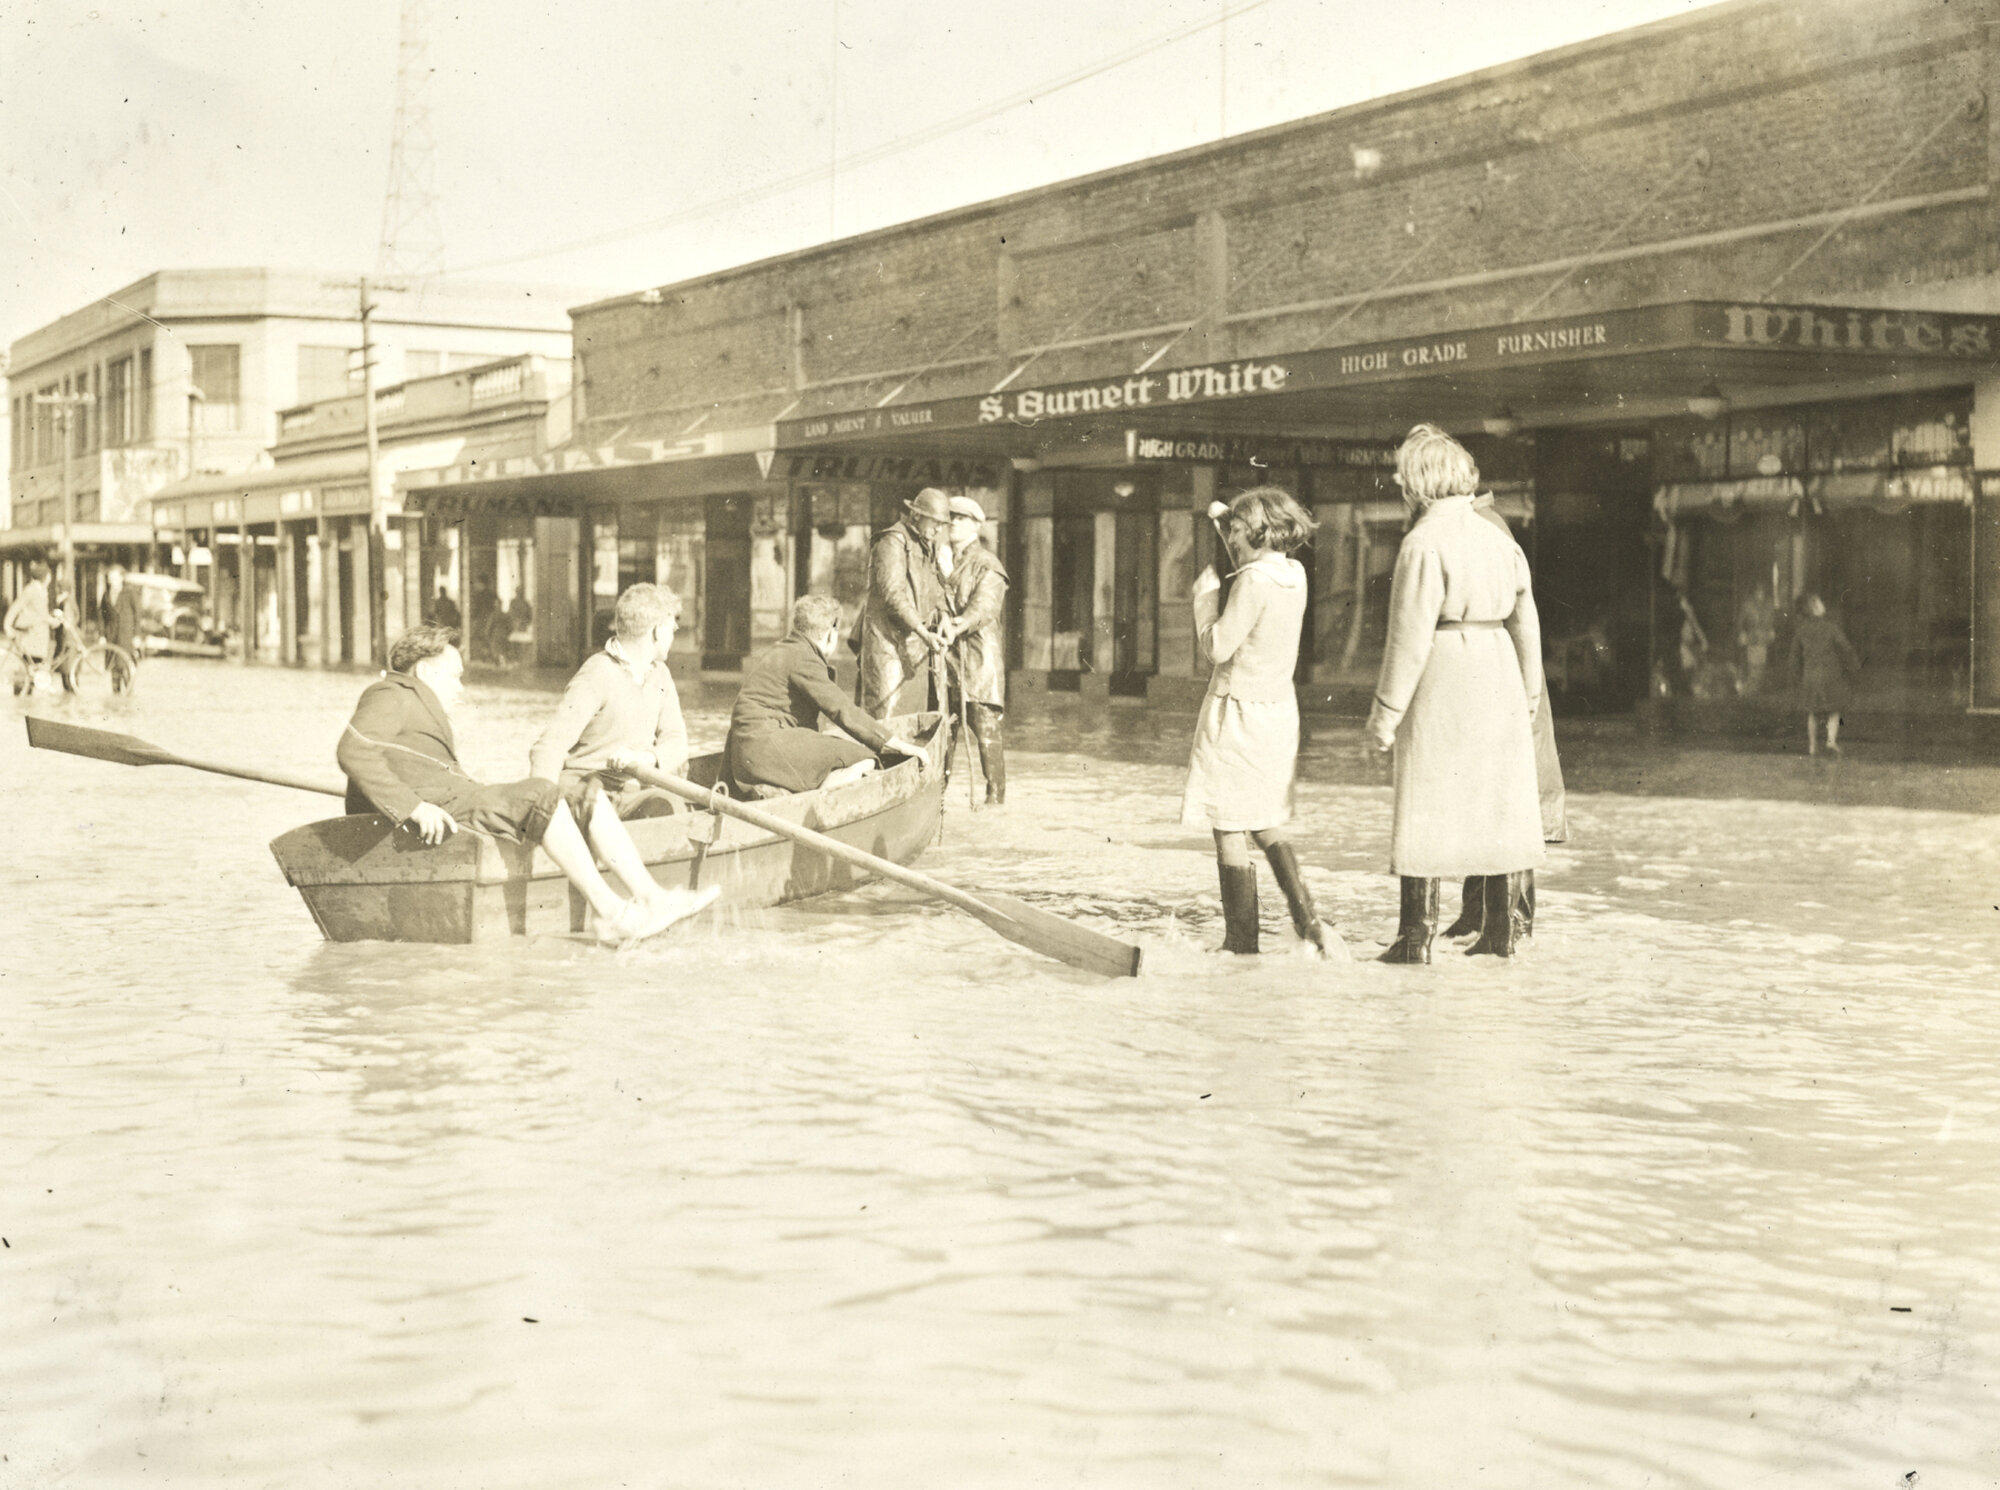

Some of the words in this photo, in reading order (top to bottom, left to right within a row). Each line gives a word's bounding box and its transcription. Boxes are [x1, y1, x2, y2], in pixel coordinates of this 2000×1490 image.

[1340, 352, 1389, 374] HIGH
[1402, 342, 1468, 366] GRADE
[1497, 325, 1607, 356] FURNISHER
[1167, 363, 1288, 401] White
[804, 422, 829, 438] LAND
[832, 416, 866, 434] AGENT
[891, 409, 934, 427] VALUER
[1174, 442, 1226, 460] GRADE
[786, 455, 997, 485] TRUMANS
